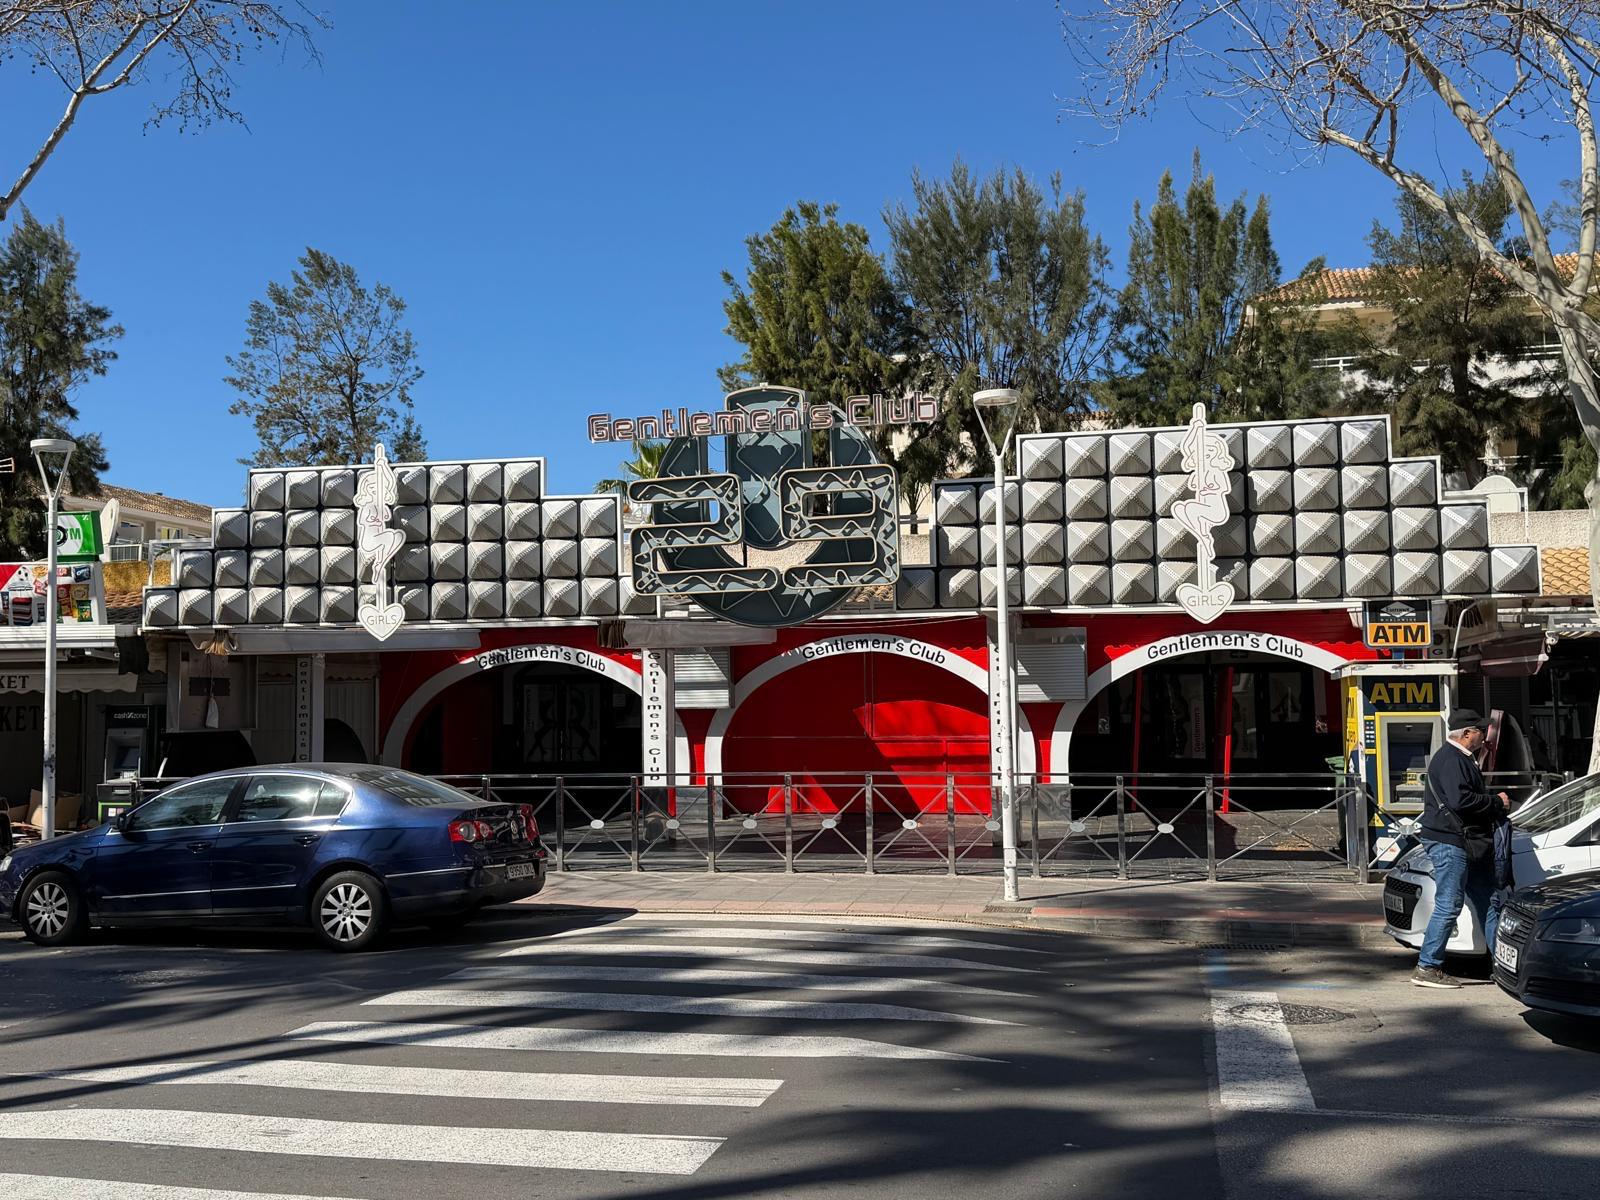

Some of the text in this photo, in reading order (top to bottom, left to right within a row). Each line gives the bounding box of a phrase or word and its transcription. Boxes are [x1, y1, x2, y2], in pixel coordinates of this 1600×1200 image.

[587, 391, 940, 443] Gentlemen's Club
[1187, 594, 1225, 607] GIRLS
[366, 614, 397, 626] GIRLS
[1373, 625, 1425, 643] ATM
[803, 638, 946, 665] Gentlemen's Club
[1147, 633, 1304, 659] Gentlemen's Club
[478, 647, 606, 672] Gentlemen's Club
[1370, 683, 1433, 704] ATM
